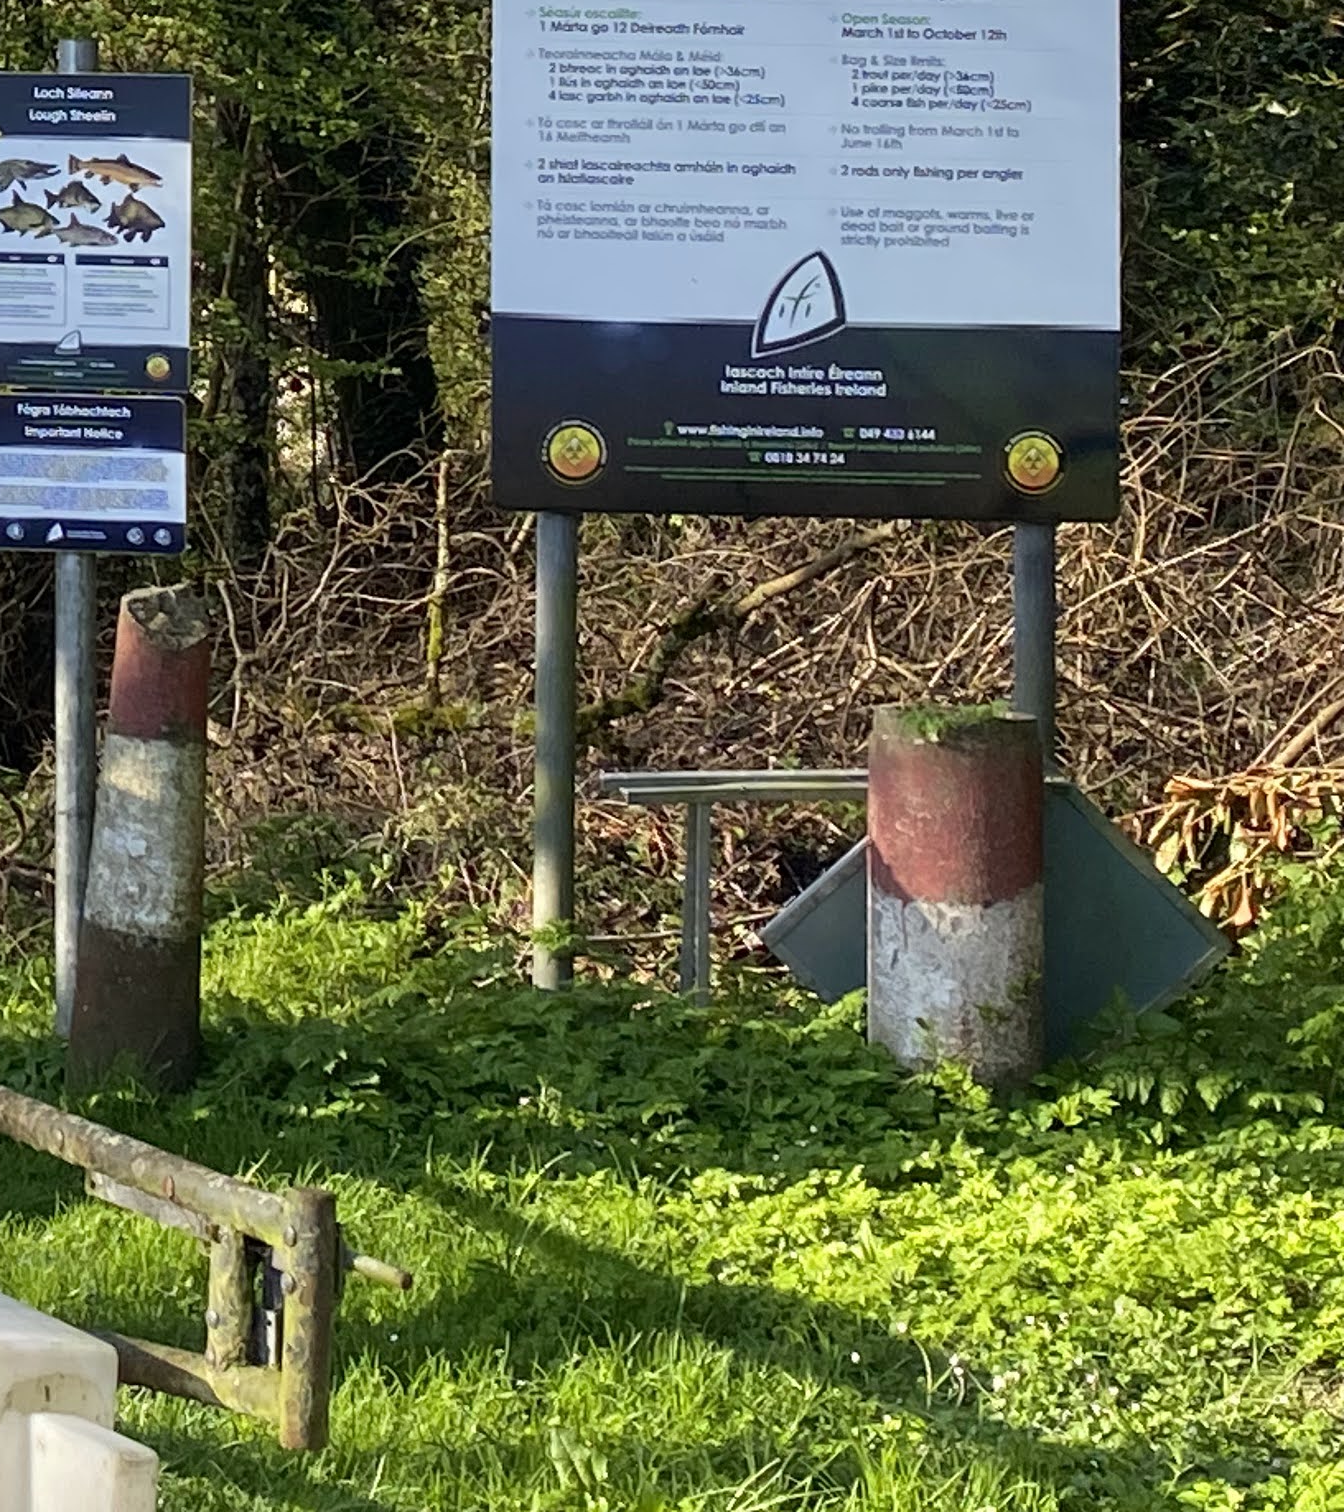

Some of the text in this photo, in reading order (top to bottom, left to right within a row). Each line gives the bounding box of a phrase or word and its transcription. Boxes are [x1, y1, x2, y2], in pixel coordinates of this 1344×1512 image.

[841, 13, 931, 26] Open Season:
[841, 27, 1007, 40] March 1st to October 12th
[841, 54, 867, 68] Bag
[883, 55, 907, 66] Size
[910, 56, 946, 67] limits:
[862, 70, 889, 80] trout
[891, 70, 941, 82] per/day
[34, 87, 65, 99] Loch
[861, 83, 889, 95] pike
[891, 84, 941, 96] per/day
[862, 99, 904, 108] coarse
[906, 97, 926, 108] fish
[928, 99, 979, 111] per/day
[29, 109, 116, 123] Lough Sheelin
[851, 166, 880, 177] rods
[882, 166, 910, 179] only
[913, 166, 954, 181] fishing
[957, 169, 979, 180] per
[981, 169, 1024, 182] angler
[725, 365, 786, 379] Iascach
[828, 364, 883, 381] Éireann
[720, 380, 887, 396] Inland Fisheries Ireland
[24, 426, 124, 439] Important Notice
